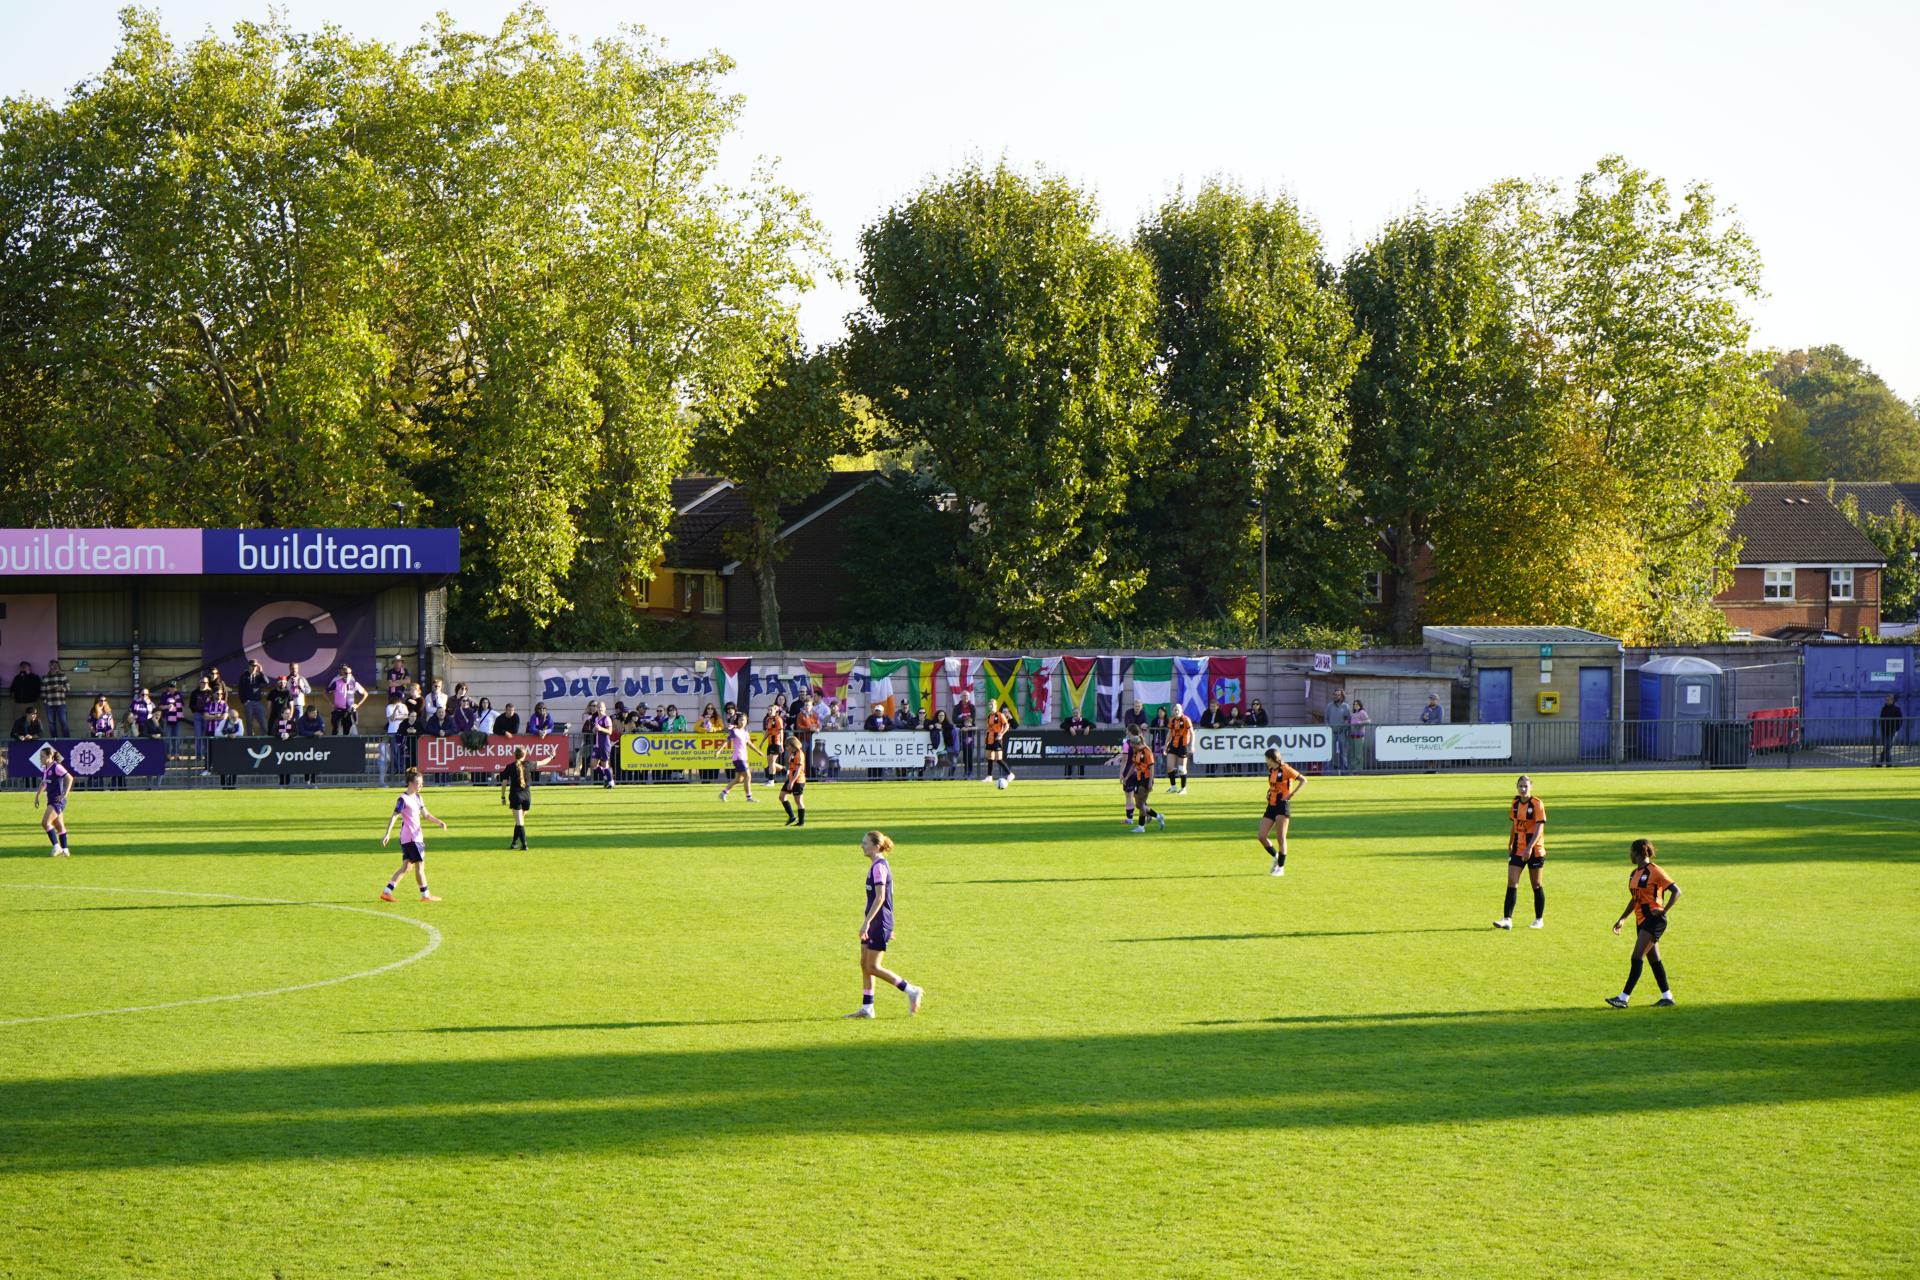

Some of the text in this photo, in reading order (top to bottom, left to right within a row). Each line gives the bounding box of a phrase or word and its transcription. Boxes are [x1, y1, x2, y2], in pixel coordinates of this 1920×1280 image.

[242, 601, 338, 679] C
[632, 736, 697, 756] QUICK
[1200, 734, 1326, 750] GETGROUND
[1386, 735, 1444, 744] Anderson
[275, 747, 331, 765] yonder
[834, 743, 934, 756] SMALL BEER
[1045, 745, 1075, 754] BRING
[1077, 745, 1093, 754] THE
